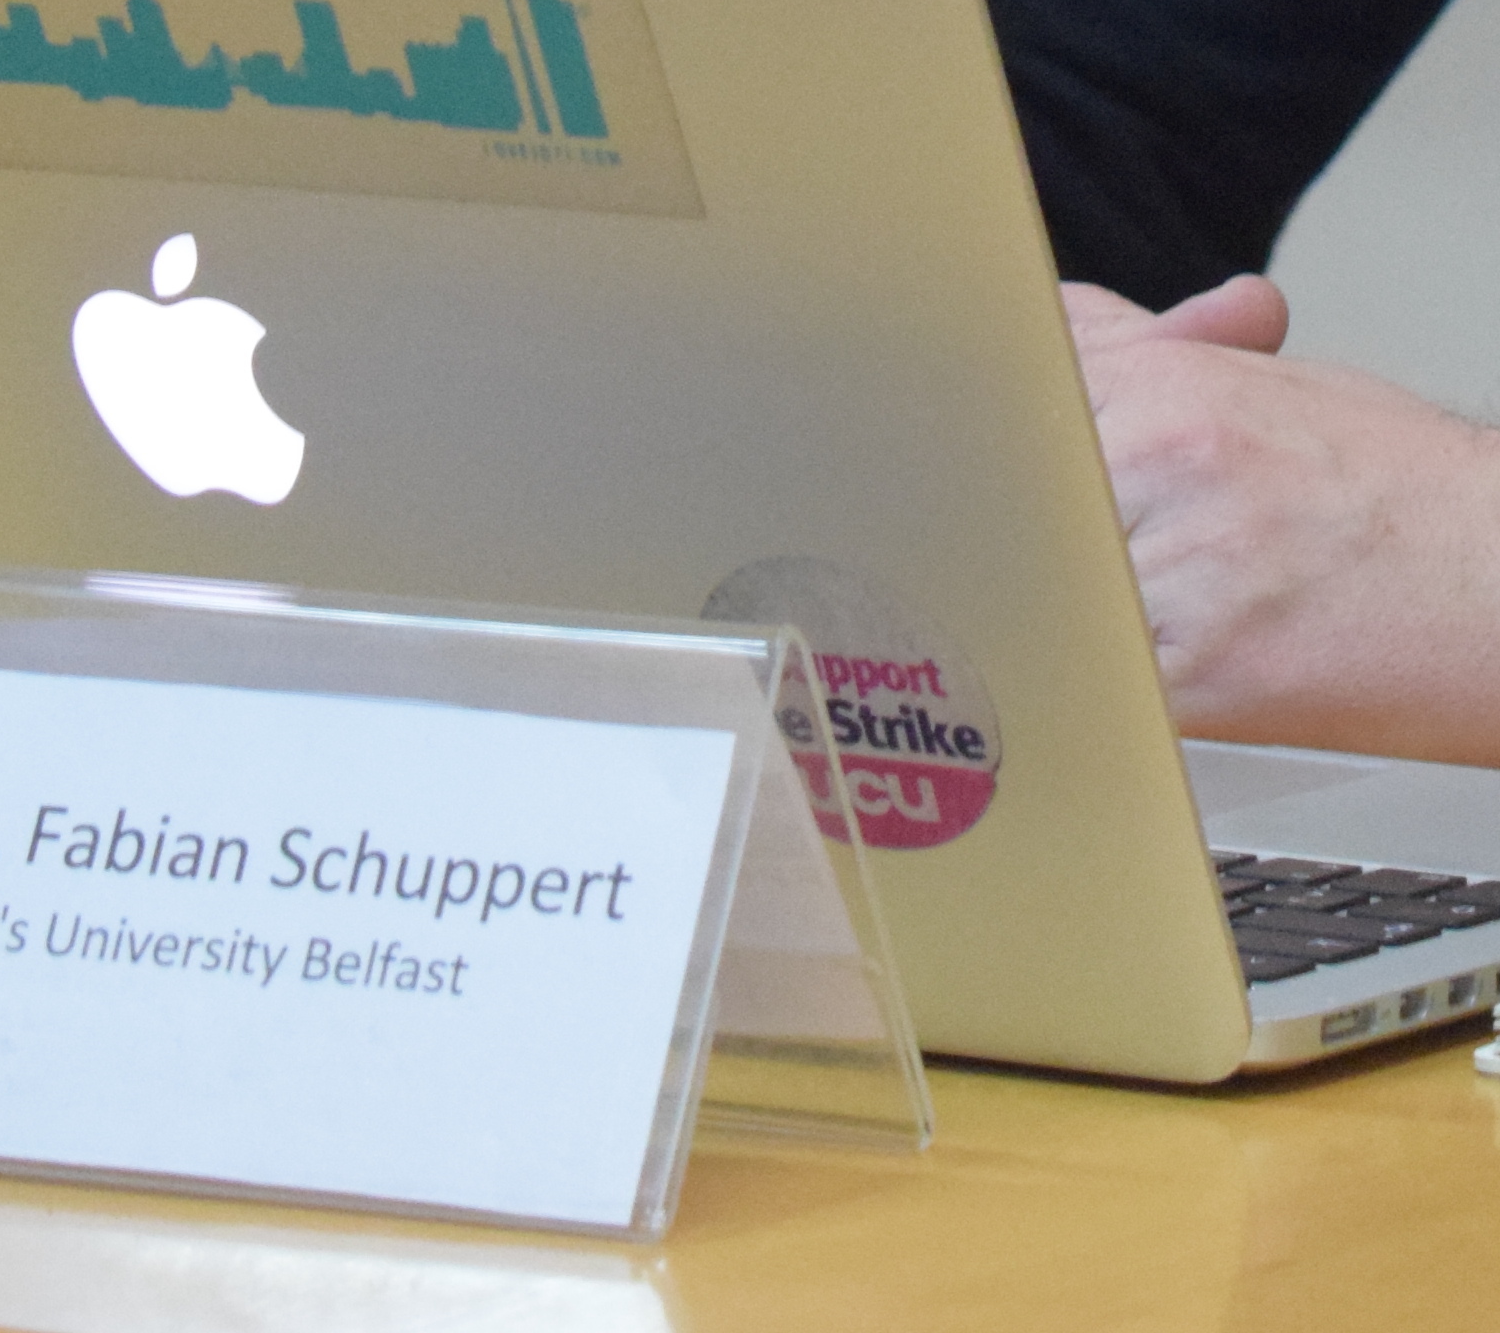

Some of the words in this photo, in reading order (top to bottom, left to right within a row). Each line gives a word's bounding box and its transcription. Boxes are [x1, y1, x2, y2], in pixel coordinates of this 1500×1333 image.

[825, 697, 987, 762] Strike
[25, 804, 250, 884] Fabian
[269, 826, 633, 923] Schuppert
[45, 912, 288, 988] University
[301, 936, 470, 997] Belfast
